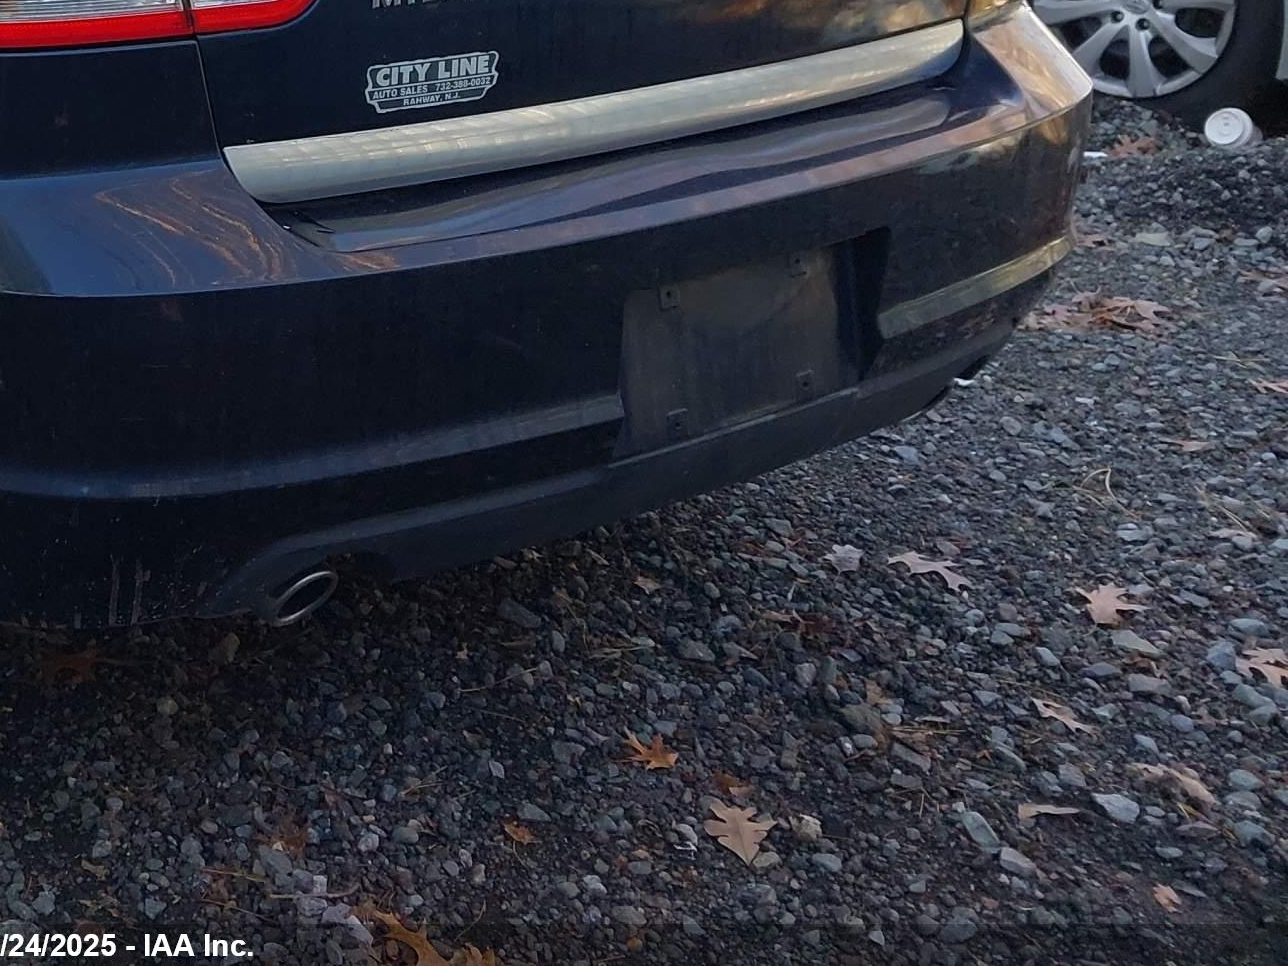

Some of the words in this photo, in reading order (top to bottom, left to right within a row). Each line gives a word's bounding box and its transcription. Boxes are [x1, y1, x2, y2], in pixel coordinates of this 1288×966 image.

[376, 63, 432, 87] CITY
[437, 54, 490, 80] LINE
[372, 88, 398, 100] AUTO
[399, 84, 429, 97] SALES
